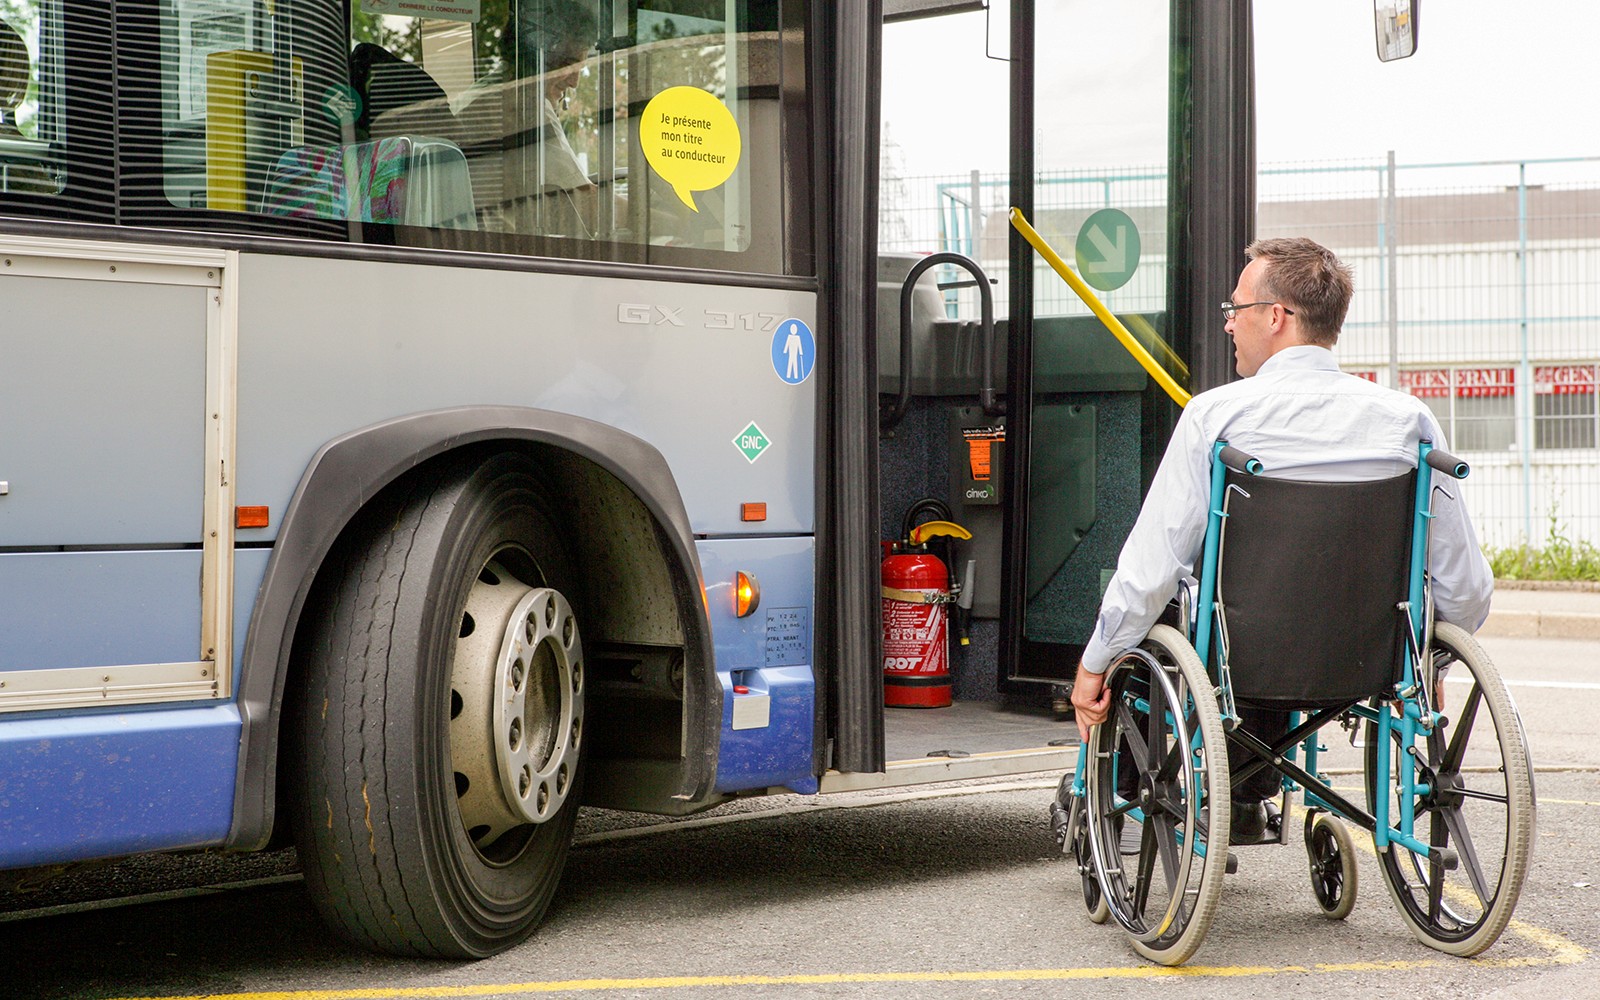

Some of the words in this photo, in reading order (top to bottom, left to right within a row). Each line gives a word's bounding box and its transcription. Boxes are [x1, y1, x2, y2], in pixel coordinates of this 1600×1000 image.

[435, 6, 473, 14] CONDUCTEUR
[661, 113, 670, 125] Je
[673, 115, 712, 130] présente
[661, 131, 681, 142] mon
[683, 132, 703, 145] titre
[662, 148, 672, 157] au
[675, 149, 726, 164] conducteur
[617, 303, 686, 327] GX
[704, 309, 787, 332] 317
[741, 435, 763, 450] GNC
